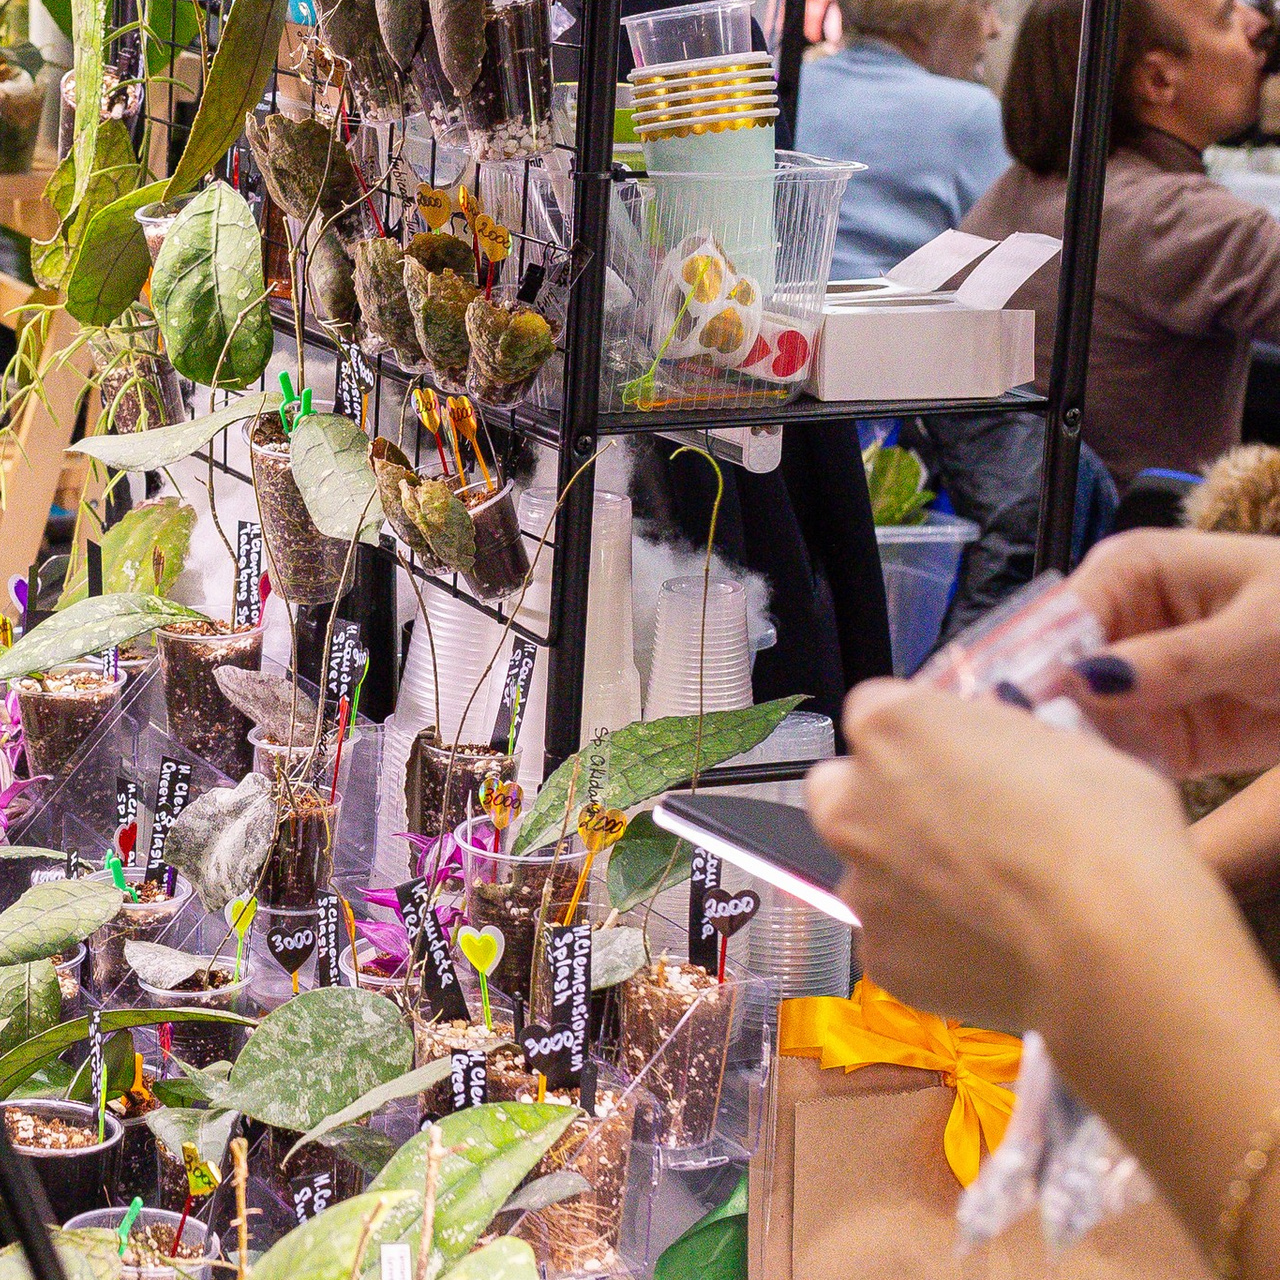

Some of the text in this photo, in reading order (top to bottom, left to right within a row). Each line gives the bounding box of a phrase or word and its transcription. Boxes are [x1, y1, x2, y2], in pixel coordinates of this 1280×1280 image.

[484, 787, 522, 810] 3000
[704, 896, 755, 919] 2000
[271, 929, 313, 953] 3000
[552, 931, 574, 1007] Splash
